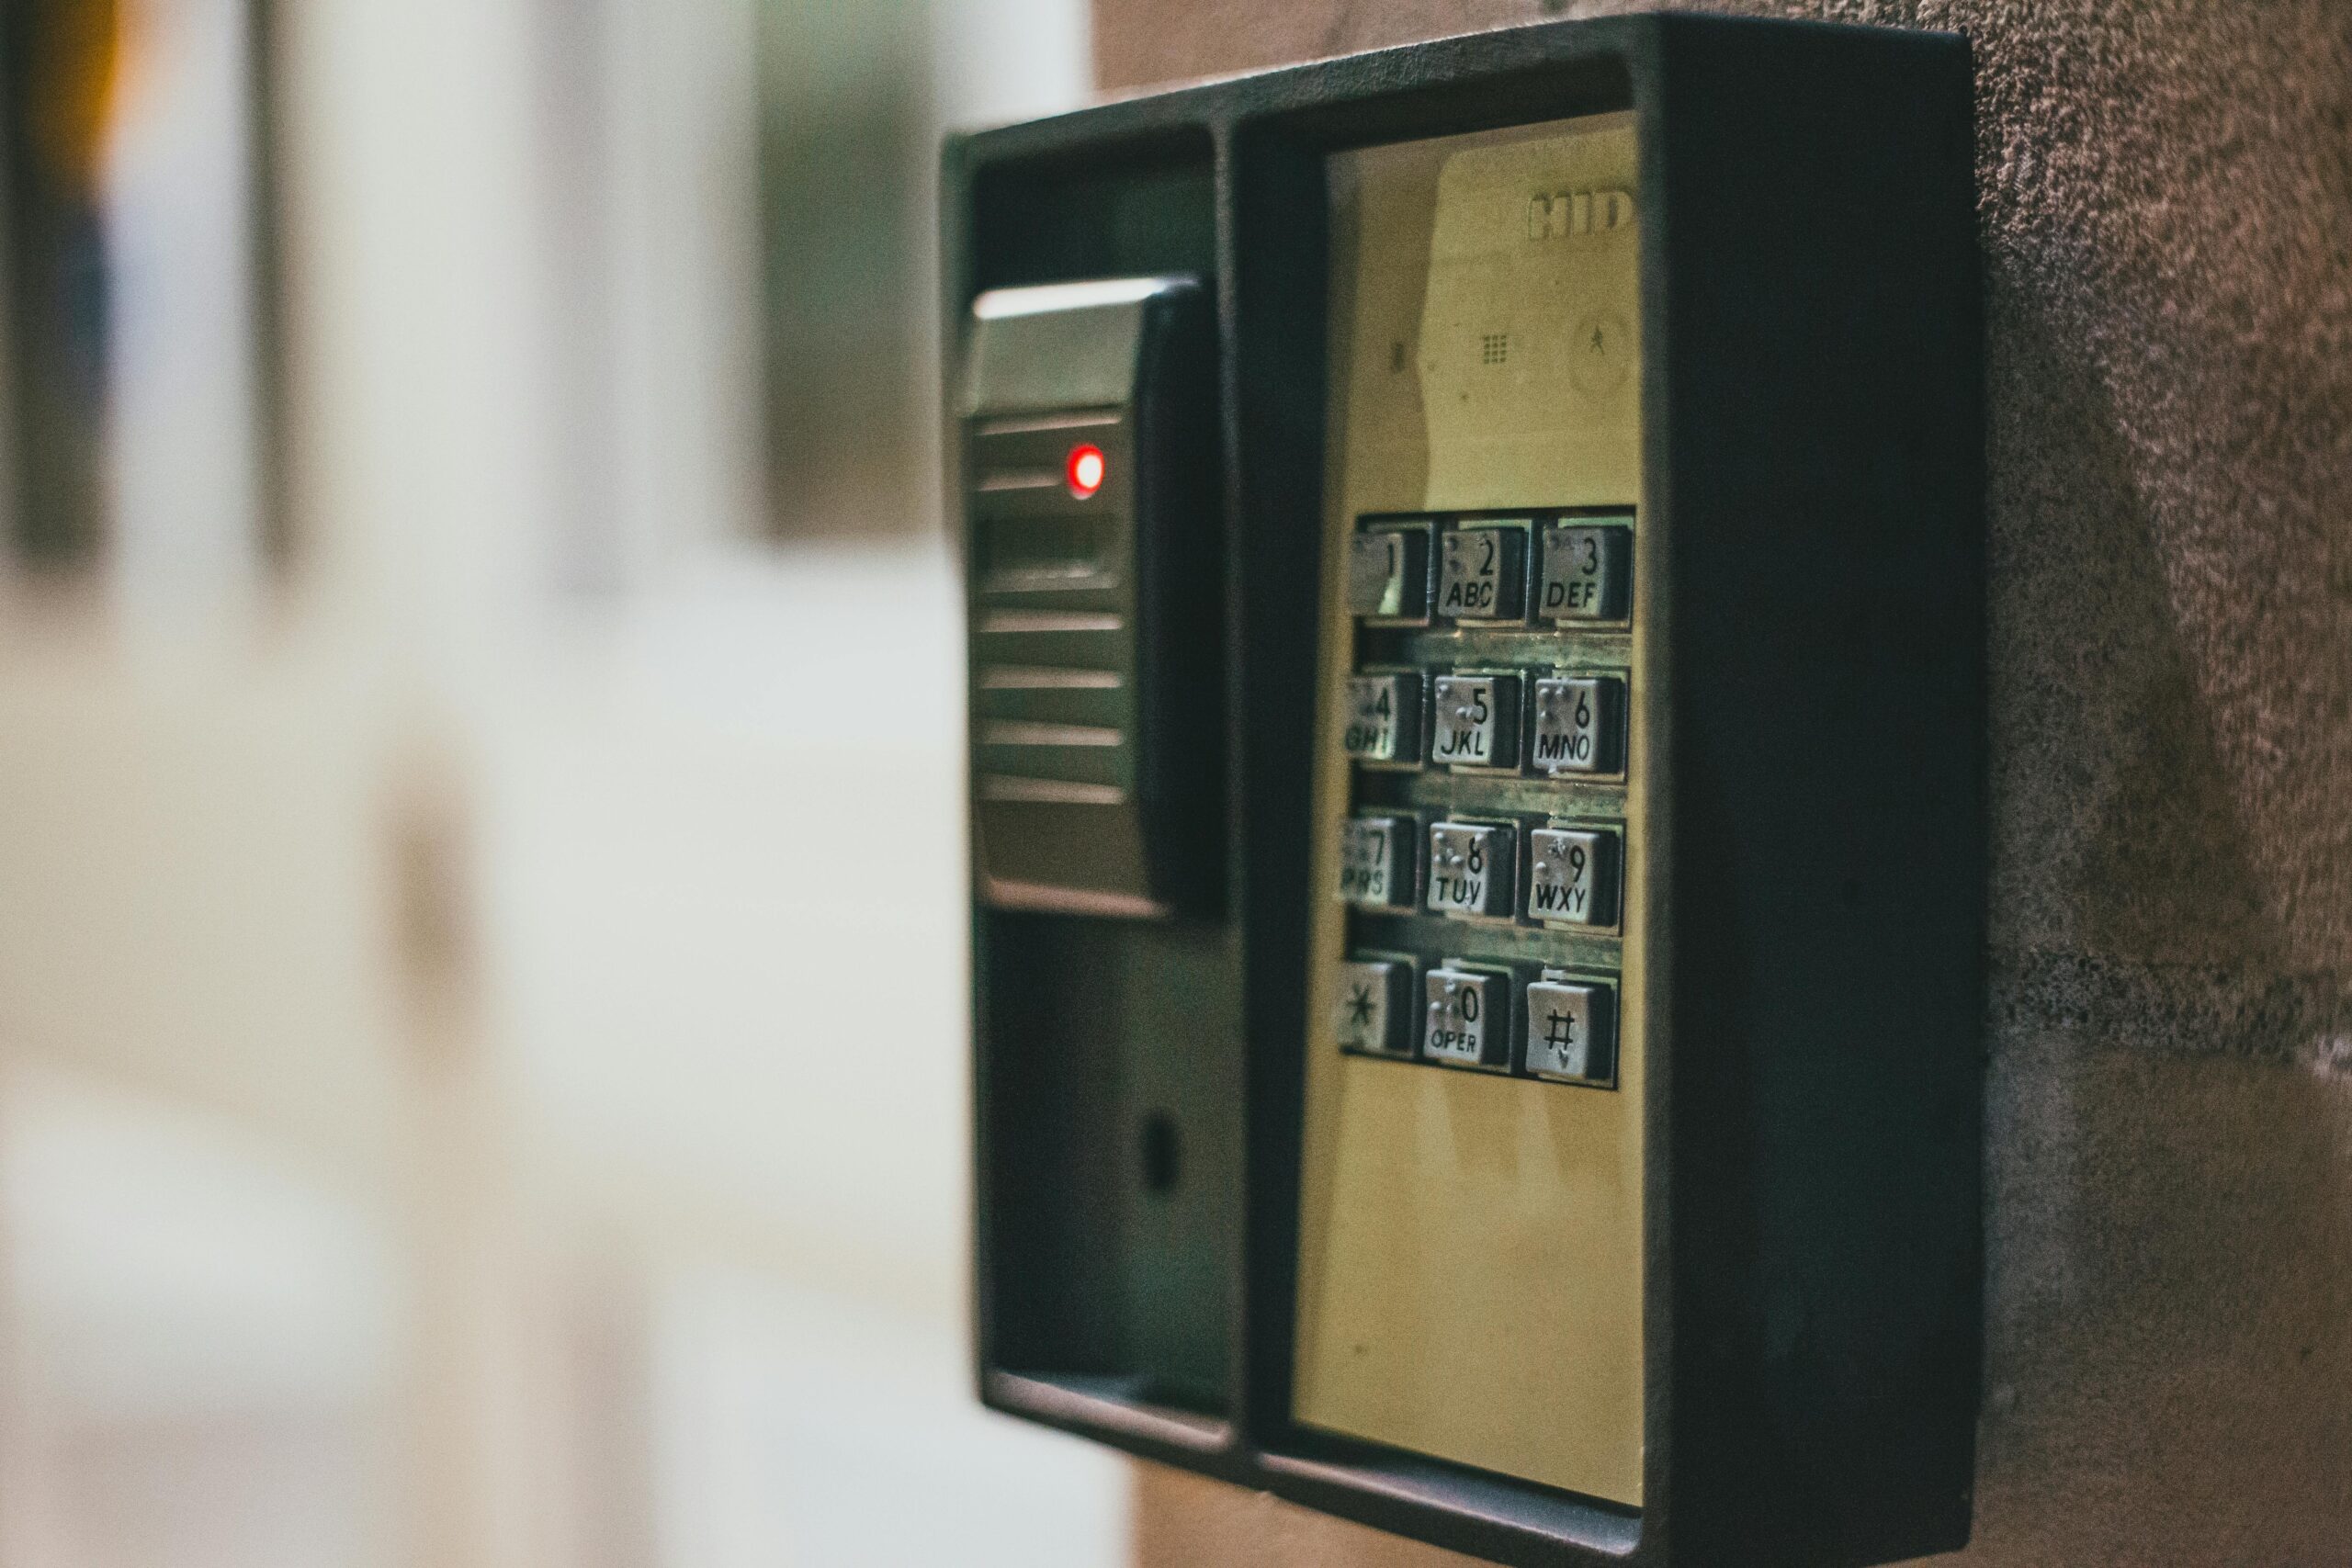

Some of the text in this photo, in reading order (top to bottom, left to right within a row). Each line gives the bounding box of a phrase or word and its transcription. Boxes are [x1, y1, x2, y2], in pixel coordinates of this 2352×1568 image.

[1528, 186, 1634, 240] HID
[1386, 543, 1395, 578] 1
[1479, 539, 1494, 576] 2
[1582, 537, 1598, 575] 3
[1445, 582, 1493, 608] ABC
[1547, 581, 1596, 607] DEF
[1375, 686, 1391, 721] 4
[1473, 688, 1487, 725] 5
[1575, 691, 1590, 728] 6
[1441, 731, 1484, 756] JKL
[1538, 734, 1589, 761] MNO
[1369, 829, 1385, 865] 7
[1468, 836, 1482, 874] 8
[1570, 845, 1586, 883] 9
[1436, 877, 1480, 907] TUV
[1535, 883, 1586, 912] WXY
[1461, 987, 1479, 1022] 0
[1430, 1029, 1476, 1053] OPER
[1544, 1009, 1575, 1051] #
